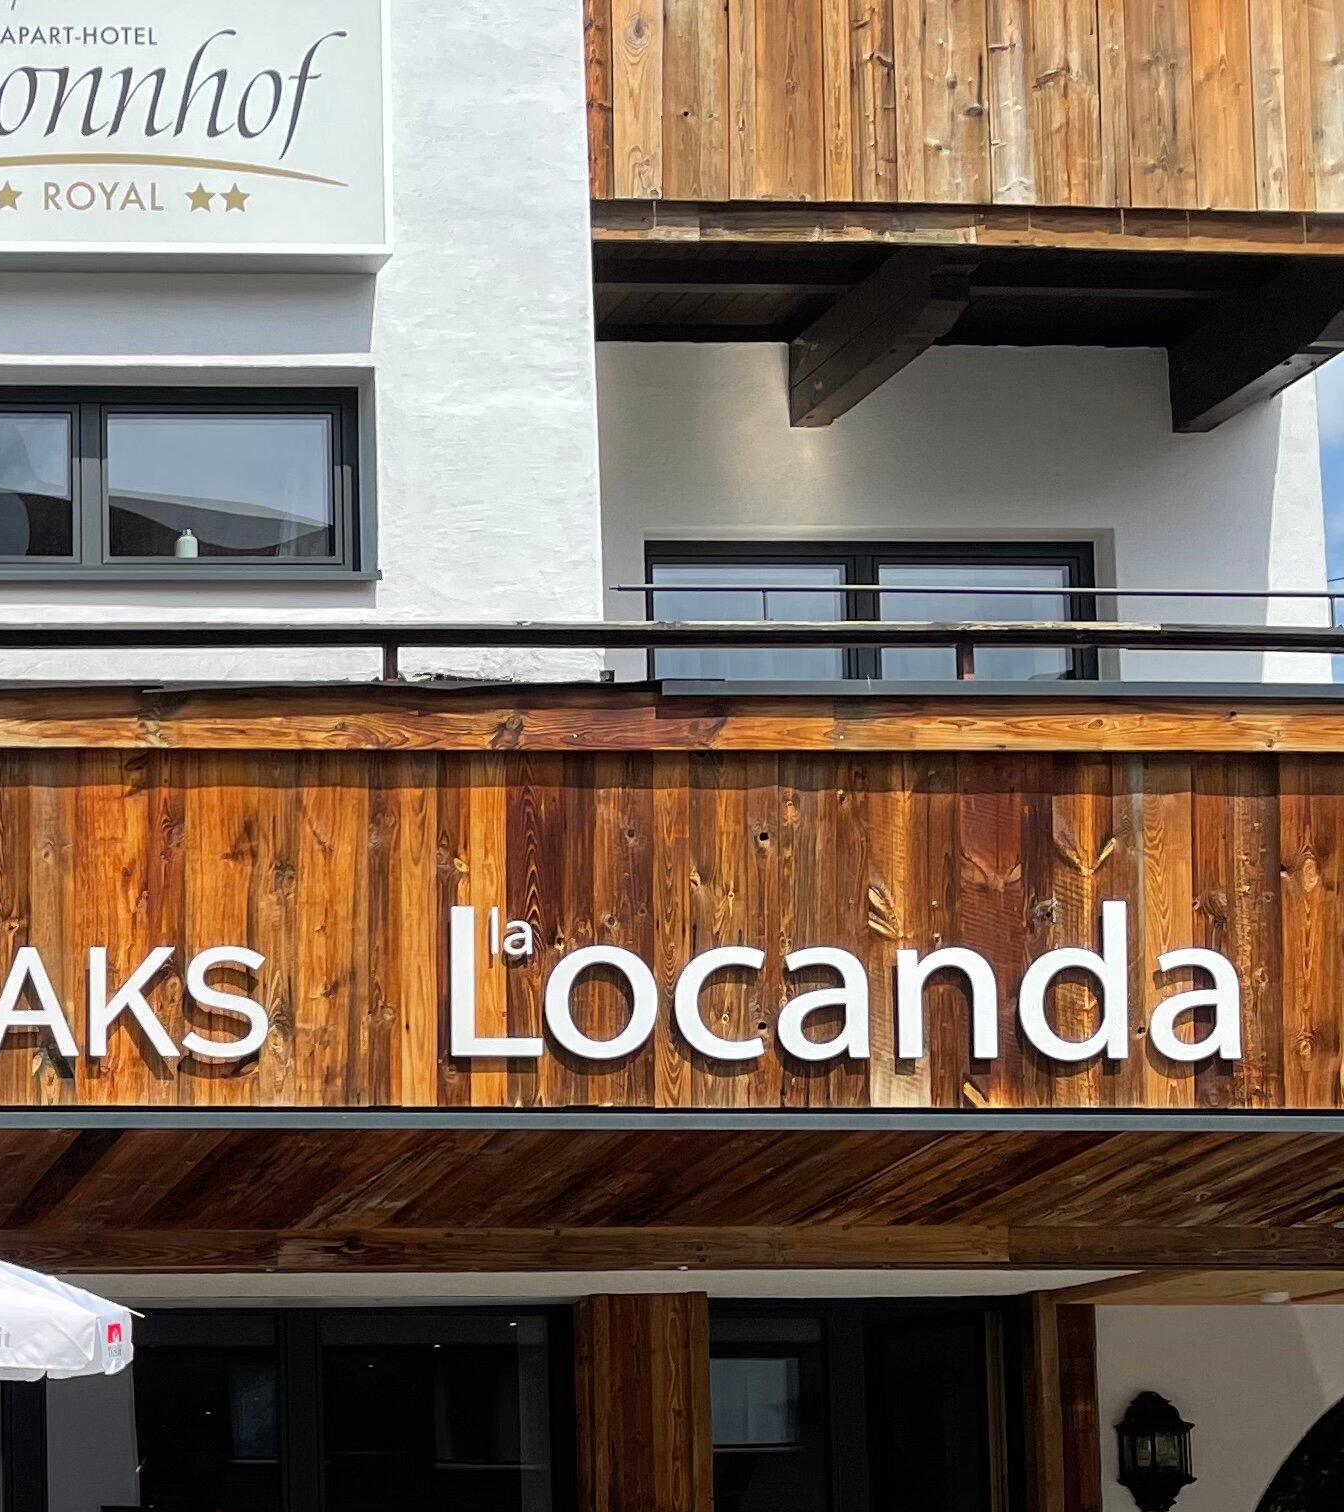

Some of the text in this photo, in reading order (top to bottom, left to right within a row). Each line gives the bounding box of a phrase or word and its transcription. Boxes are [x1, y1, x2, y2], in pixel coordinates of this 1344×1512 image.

[42, 181, 165, 212] ROYAL
[449, 899, 1243, 1063] la Locanda
